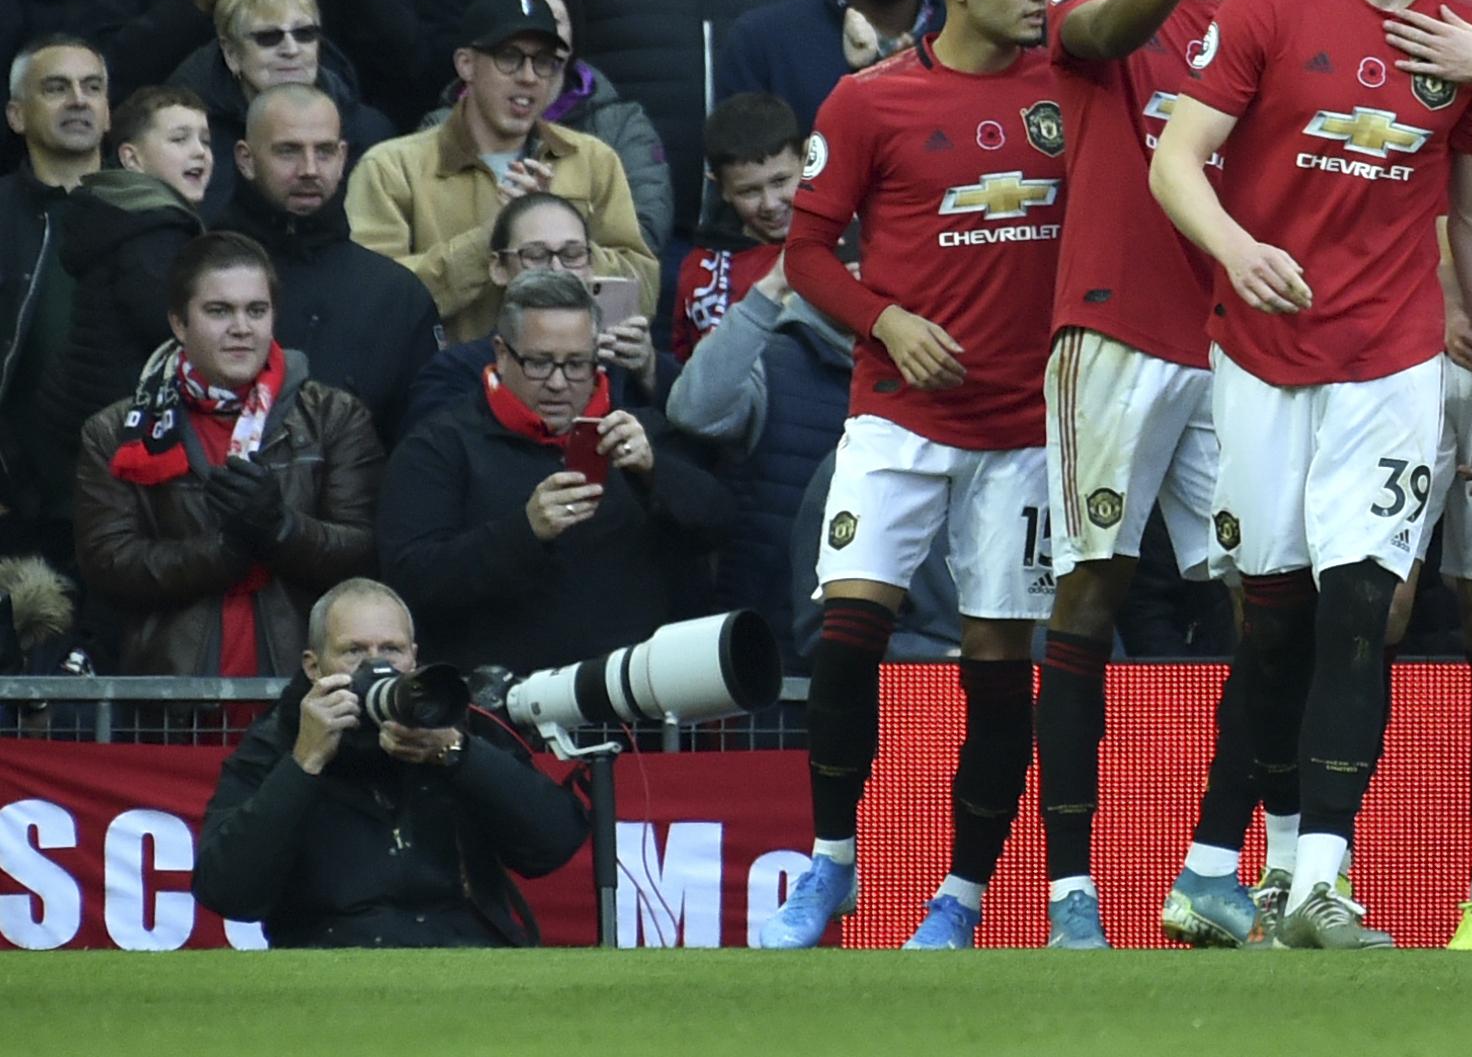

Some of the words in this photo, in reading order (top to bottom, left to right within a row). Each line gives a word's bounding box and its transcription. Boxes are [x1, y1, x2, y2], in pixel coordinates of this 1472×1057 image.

[938, 224, 1061, 247] CHEVROLET
[1370, 457, 1431, 523] 39
[0, 799, 269, 951] SC
